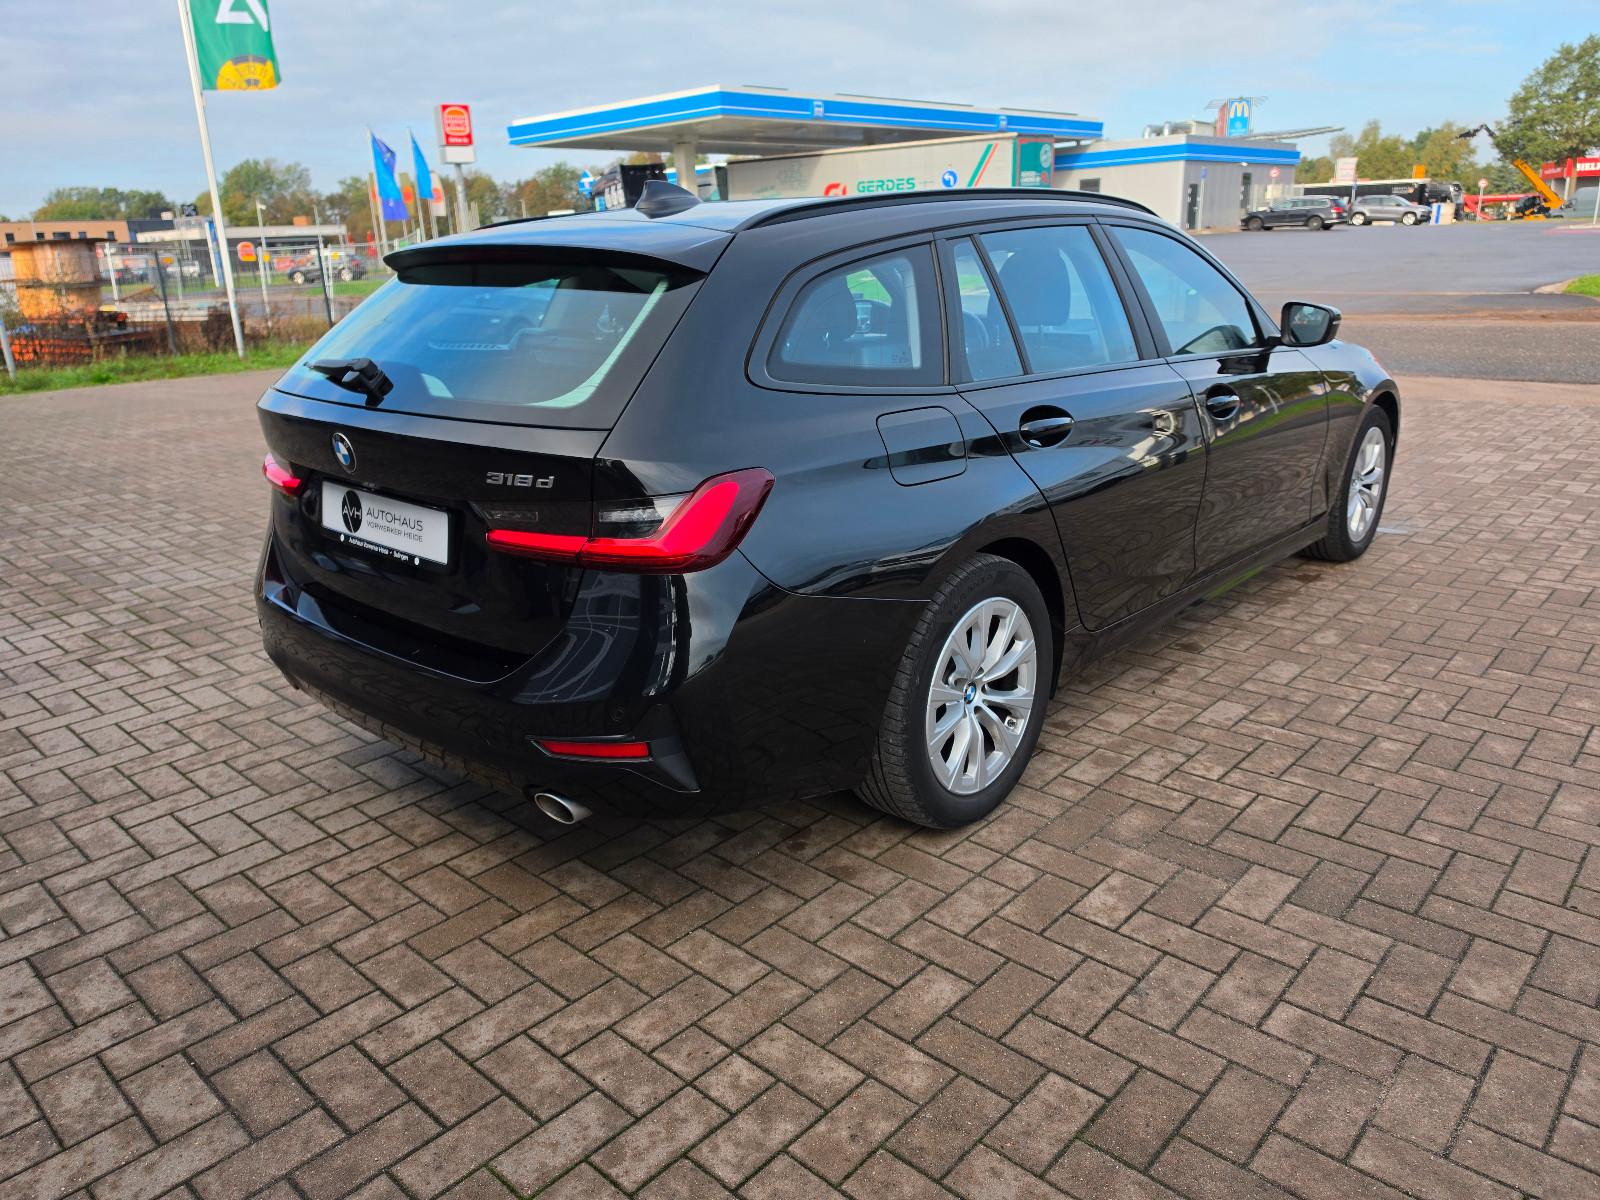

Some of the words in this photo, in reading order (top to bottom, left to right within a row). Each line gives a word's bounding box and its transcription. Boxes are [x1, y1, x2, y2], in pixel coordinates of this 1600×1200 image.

[856, 177, 916, 193] GERDES
[366, 506, 424, 532] AUTOHAUS
[403, 532, 424, 543] HEIDE
